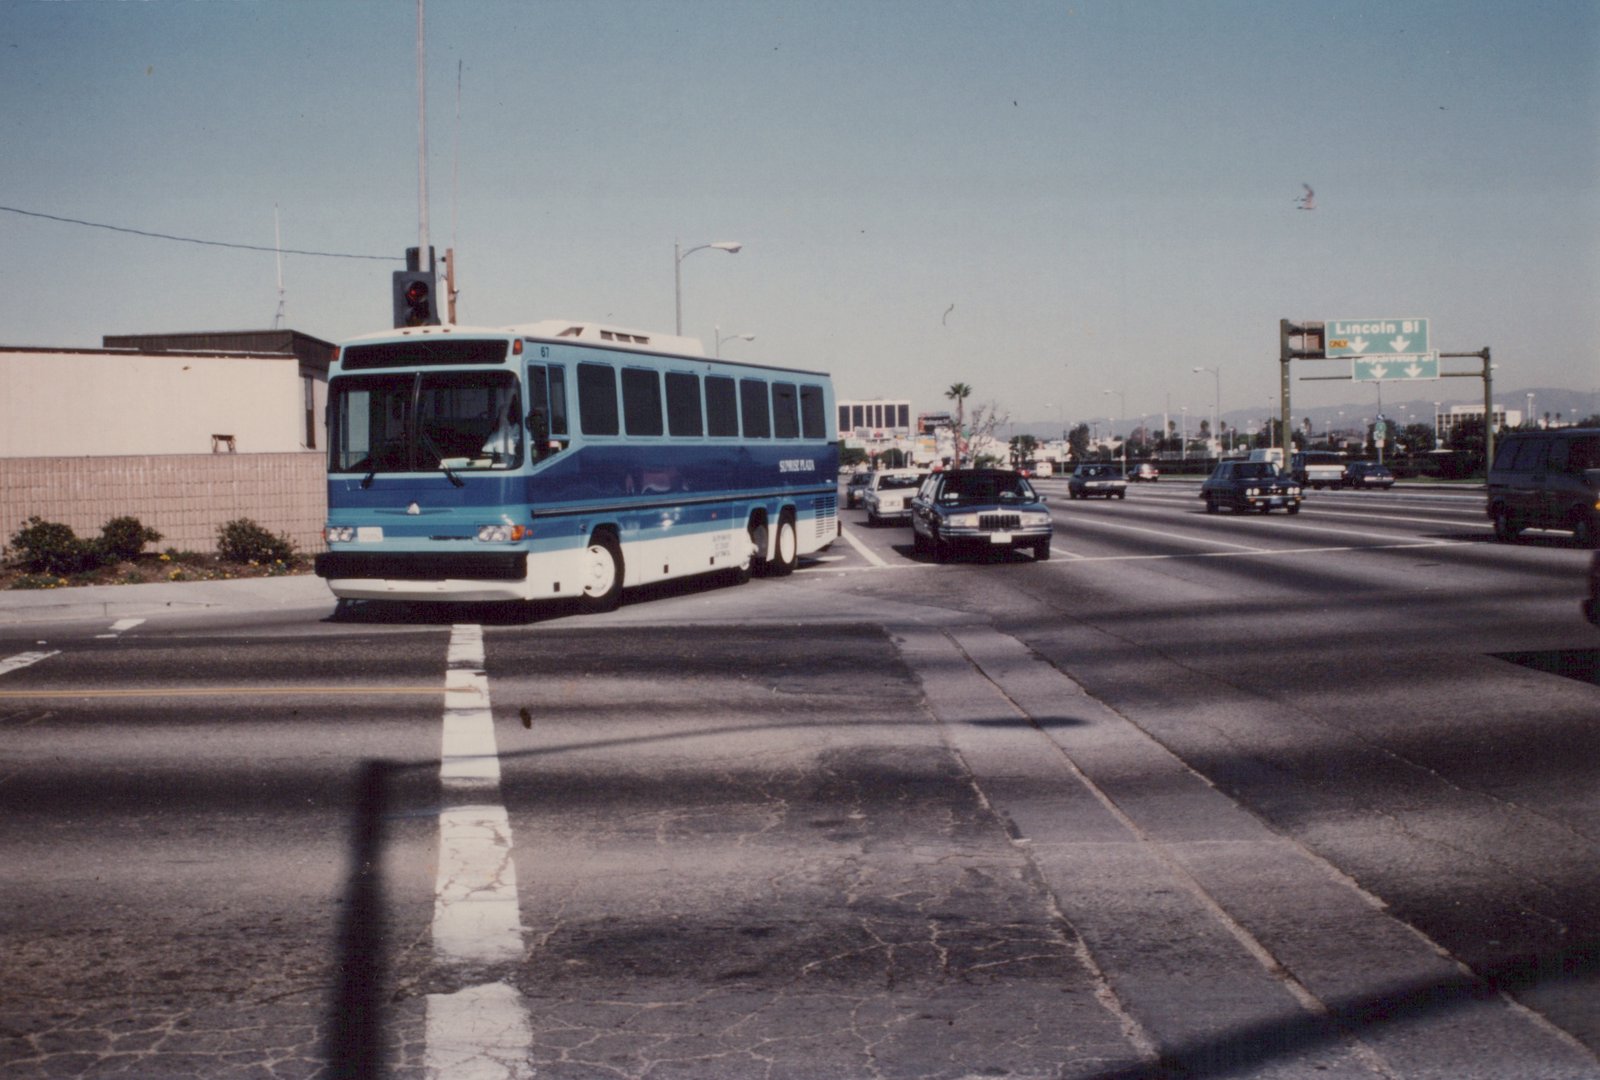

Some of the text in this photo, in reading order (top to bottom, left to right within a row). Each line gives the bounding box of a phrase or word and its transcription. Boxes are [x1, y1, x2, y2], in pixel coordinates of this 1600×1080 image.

[1335, 320, 1420, 335] Lincoln Bl
[540, 345, 550, 358] 67
